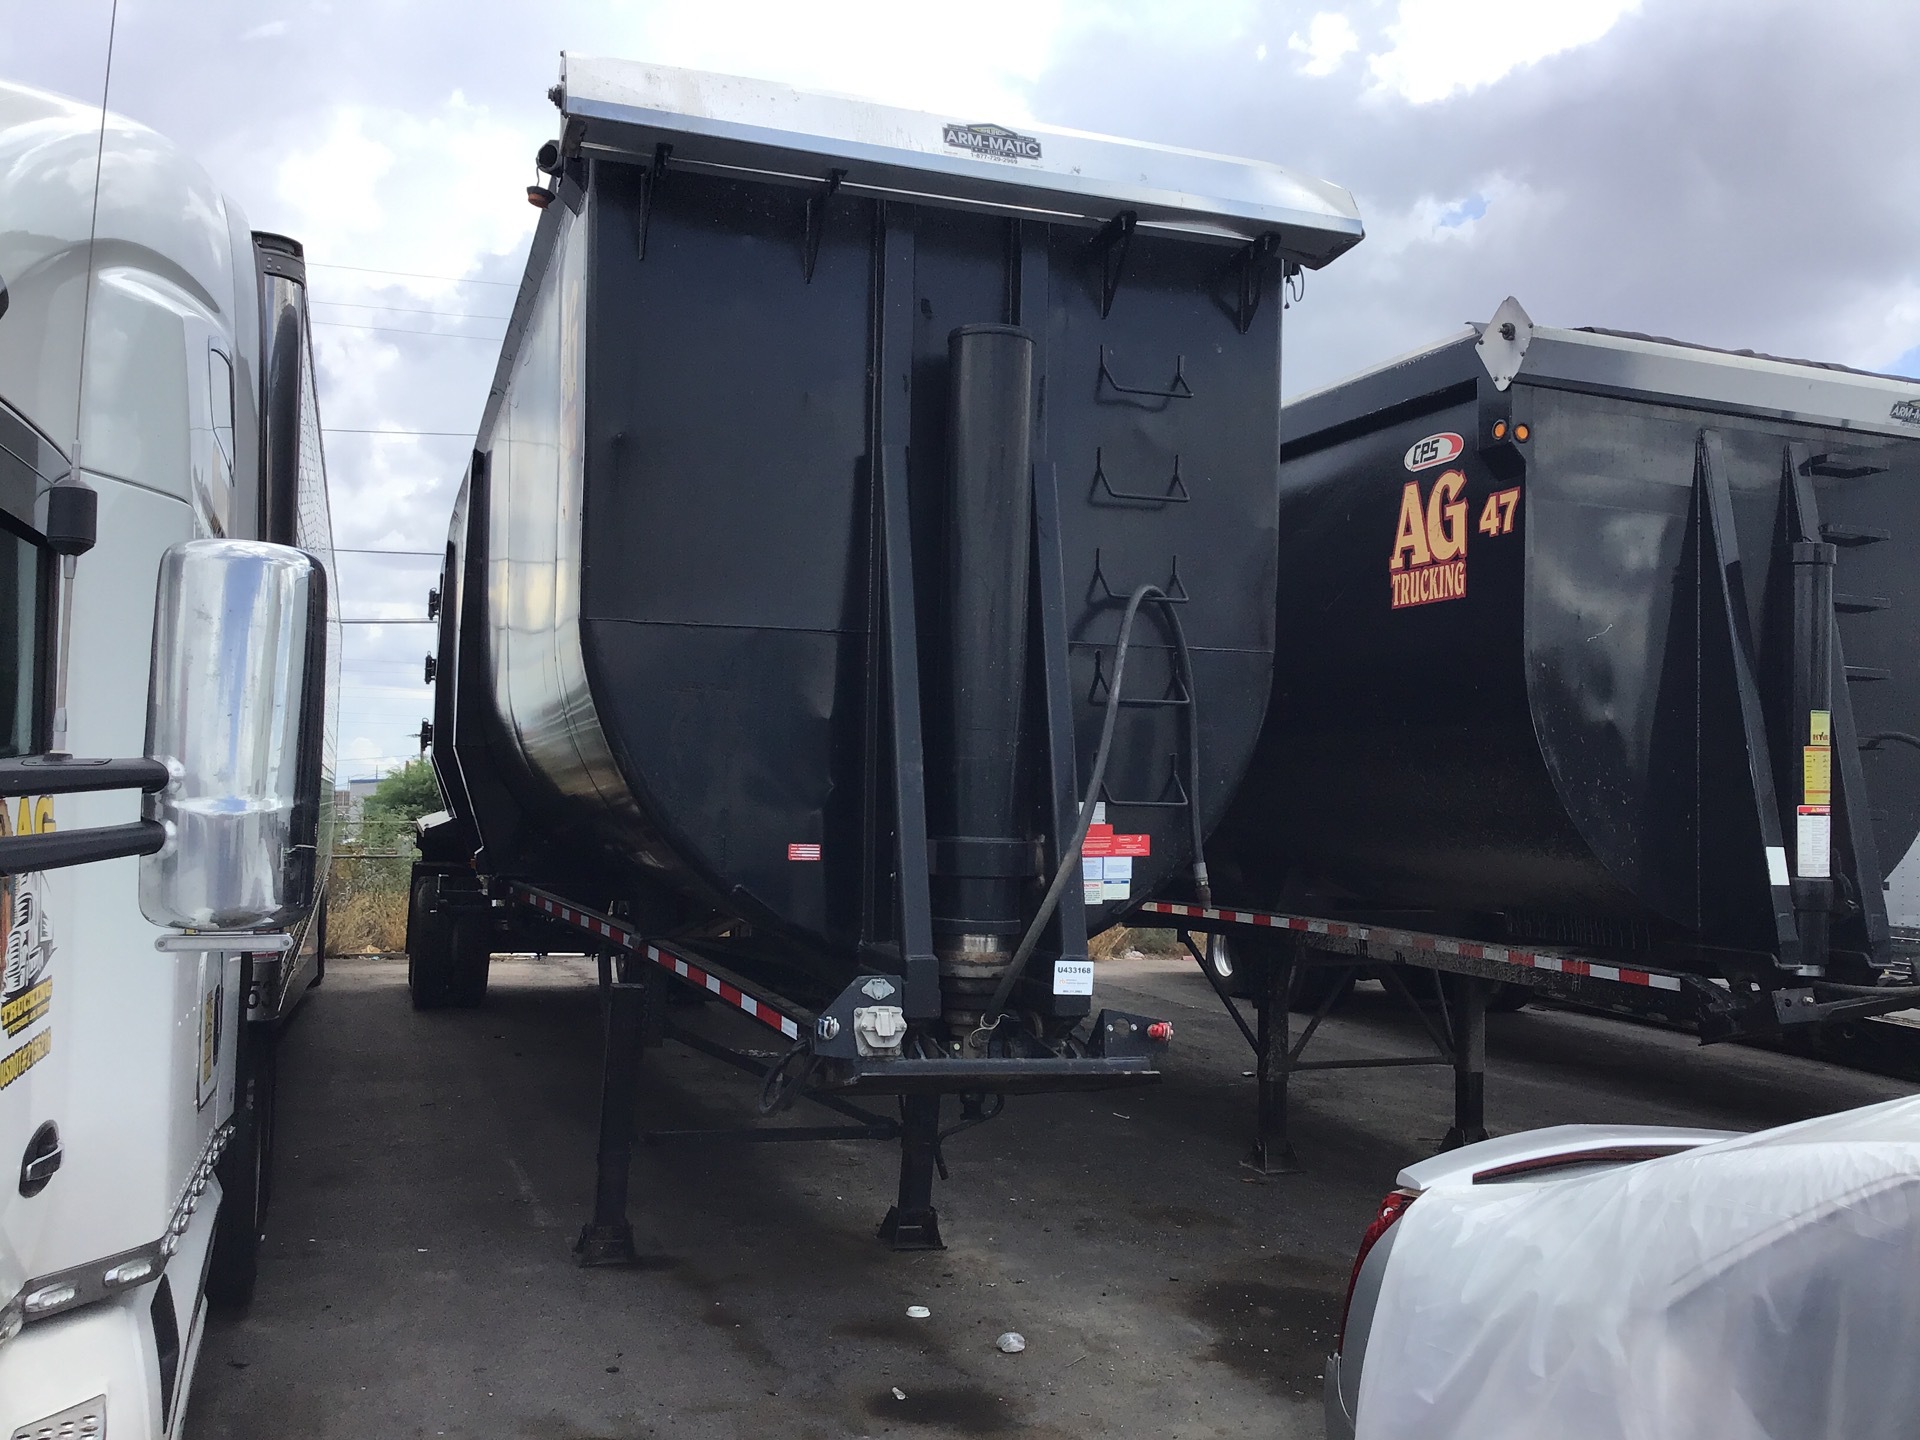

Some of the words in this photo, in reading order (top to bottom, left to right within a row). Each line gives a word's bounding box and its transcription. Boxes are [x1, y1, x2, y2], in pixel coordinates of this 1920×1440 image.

[946, 130, 1039, 156] ARM-MATIC
[1412, 439, 1440, 465] CPS
[1390, 470, 1469, 572] AG
[1479, 487, 1520, 537] 47
[1392, 561, 1467, 608] TRUCKING
[1057, 966, 1091, 974] U433168
